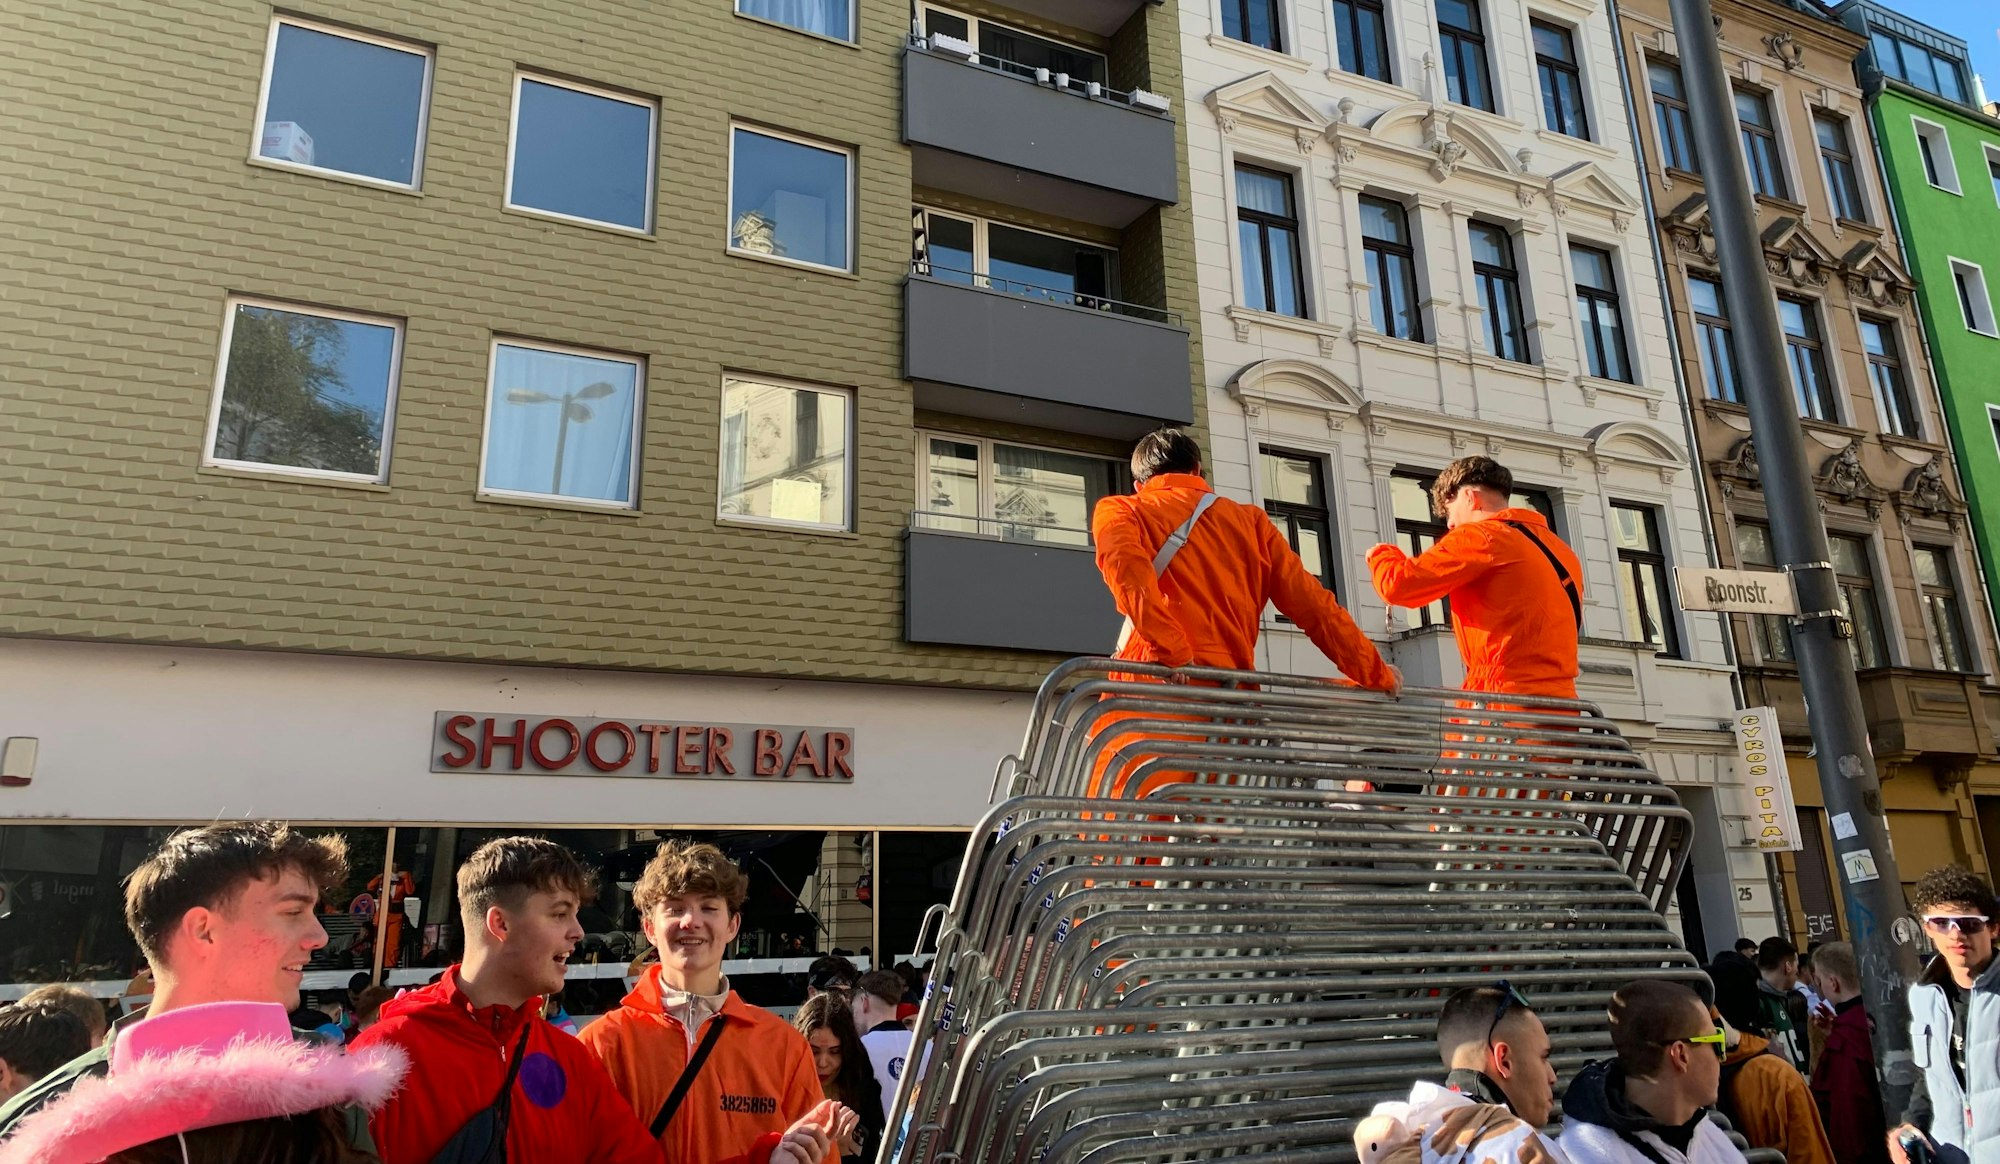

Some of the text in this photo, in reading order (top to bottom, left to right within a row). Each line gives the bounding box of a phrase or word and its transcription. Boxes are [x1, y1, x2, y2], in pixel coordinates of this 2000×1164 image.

[1705, 576, 1773, 604] Roonstr.
[441, 714, 855, 779] SHOOTER BAR
[1740, 715, 1783, 837] GYROS PITA
[1738, 887, 1752, 901] 25
[720, 1094, 777, 1115] 3825869
